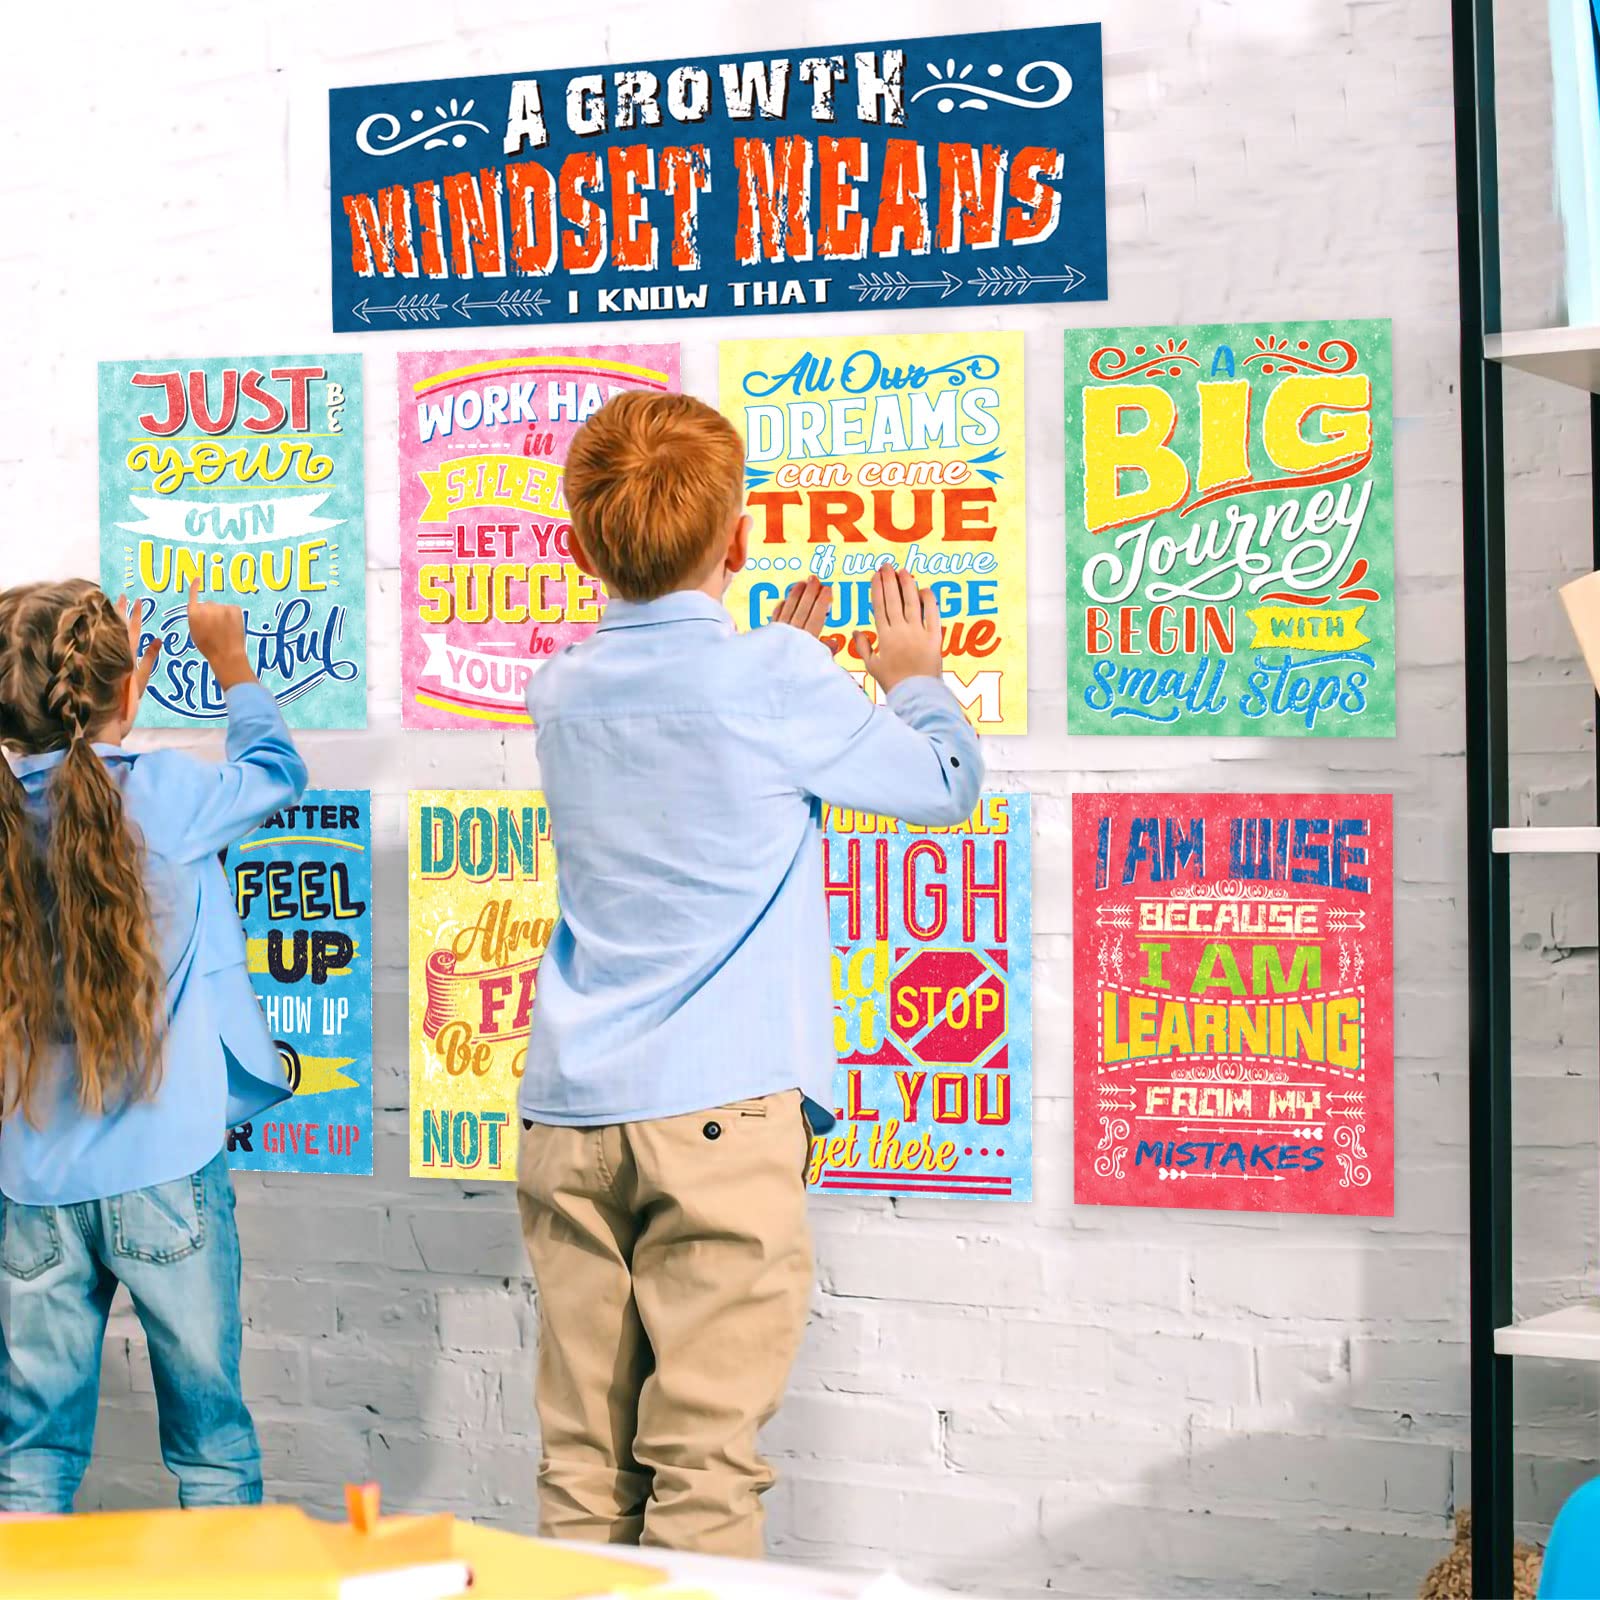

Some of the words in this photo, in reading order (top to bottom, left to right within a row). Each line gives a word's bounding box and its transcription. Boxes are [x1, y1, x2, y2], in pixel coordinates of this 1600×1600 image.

[503, 79, 550, 157] A
[565, 48, 908, 138] GROWTH
[342, 143, 712, 280] MINDSET
[733, 132, 1065, 267] MEANS
[568, 290, 580, 315] I
[598, 283, 709, 314] KNOW
[727, 276, 834, 308] THAT
[742, 351, 835, 397] All
[840, 349, 968, 394] Our
[1210, 344, 1236, 378] A
[131, 367, 327, 438] JUST
[415, 380, 539, 444] WORK
[547, 380, 627, 423] HA
[745, 387, 1001, 464] DREAMS
[523, 423, 559, 457] in
[1082, 374, 1373, 535] BIG
[126, 442, 336, 495] your
[775, 462, 852, 489] can
[857, 458, 972, 487] come
[184, 503, 277, 541] OWN
[745, 486, 998, 544] TRUE
[1082, 478, 1374, 604] Journey
[456, 524, 521, 560] LET
[810, 545, 837, 580] if
[904, 543, 998, 576] have
[418, 562, 609, 626] SUCCE
[529, 627, 555, 655] be
[1085, 605, 1236, 656] BEGIN
[1270, 615, 1345, 638] WITH
[1084, 656, 1229, 715] Small
[1239, 651, 1376, 730] steps
[258, 805, 361, 830] ATTER
[1095, 817, 1111, 892] I
[1121, 817, 1206, 887] AM
[1228, 817, 1372, 894] WISE
[235, 861, 366, 921] FEEL
[1137, 902, 1319, 934] BECAUSE
[267, 928, 355, 986] UP
[1138, 943, 1171, 990] I
[1189, 944, 1322, 996] AM
[322, 996, 349, 1036] UP
[895, 986, 1000, 1030] STOP
[1103, 990, 1362, 1072] LEARNING
[435, 1021, 494, 1077] Be
[893, 1070, 1011, 1126] YOU
[1145, 1086, 1253, 1119] FROM
[1268, 1090, 1322, 1120] MY
[262, 1122, 320, 1156] GIVE
[327, 1124, 361, 1157] UP
[422, 1109, 510, 1170] NOT
[808, 1122, 862, 1185] get
[1135, 1140, 1326, 1172] MISTAKES
